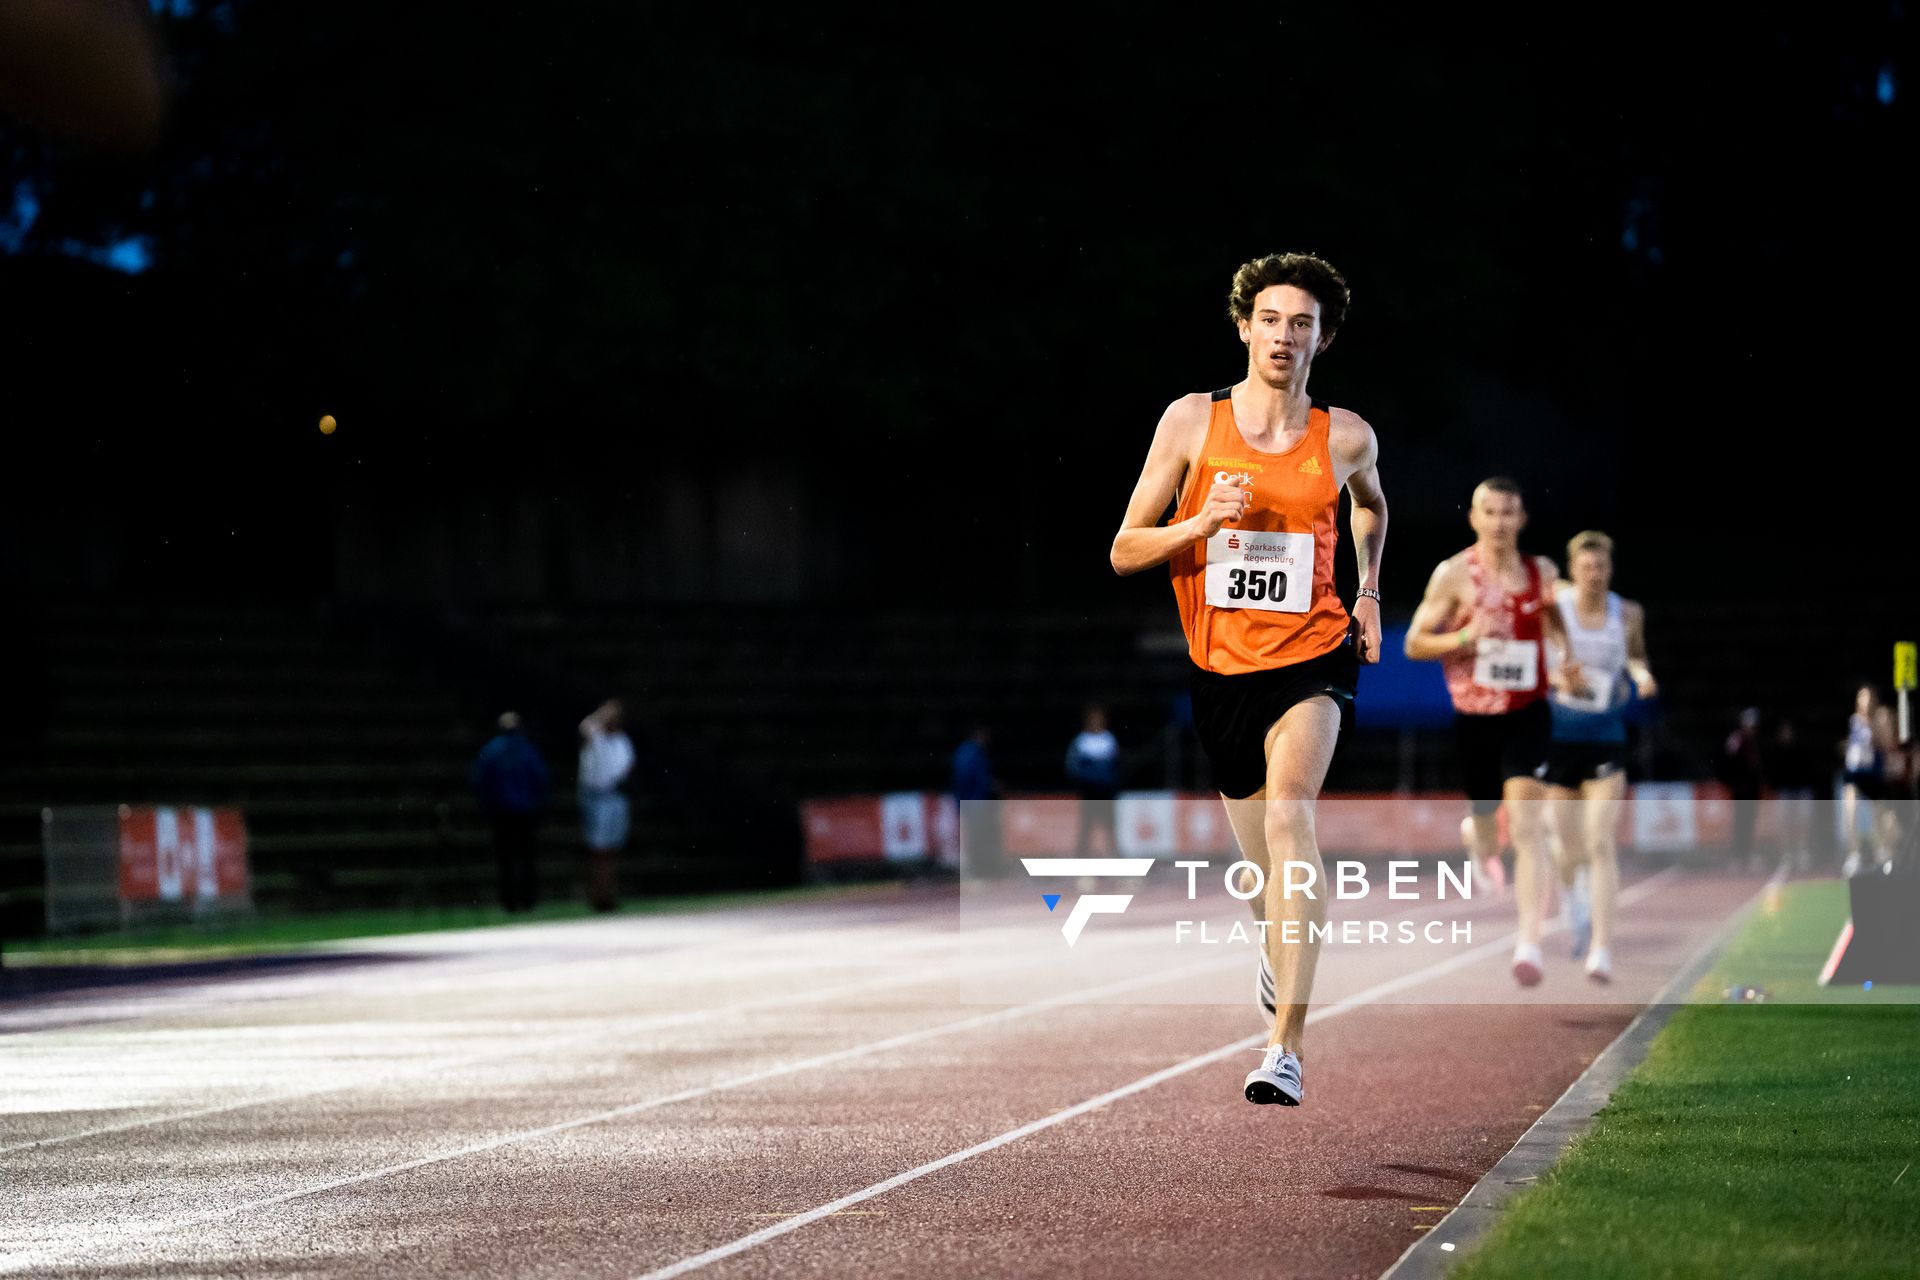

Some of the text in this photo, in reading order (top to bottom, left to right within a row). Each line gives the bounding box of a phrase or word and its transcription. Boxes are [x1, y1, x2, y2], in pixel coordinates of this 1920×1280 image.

[1244, 543, 1287, 552] Sparkasse
[1244, 554, 1295, 565] Regensburg
[1227, 568, 1288, 602] 350
